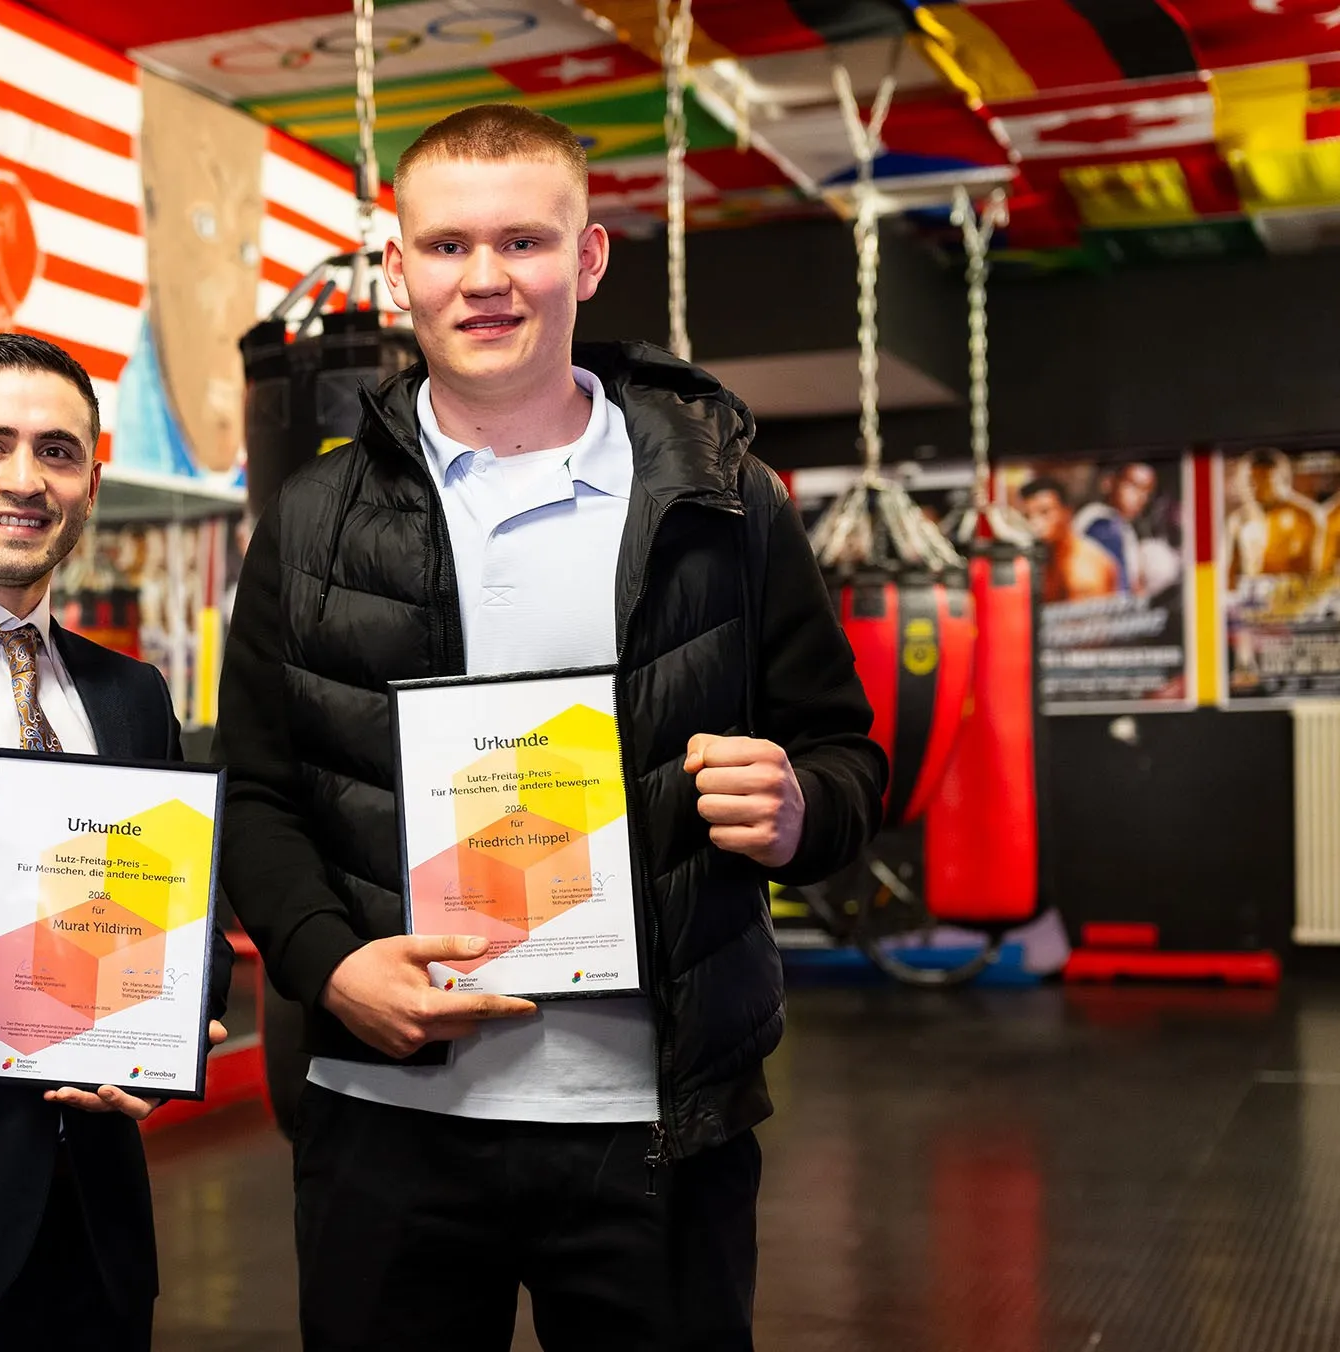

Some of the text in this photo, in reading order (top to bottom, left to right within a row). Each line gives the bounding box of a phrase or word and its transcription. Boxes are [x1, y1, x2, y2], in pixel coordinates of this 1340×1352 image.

[474, 733, 549, 751] Urkunde
[467, 770, 552, 783] Lutz-Freitag-Preis
[431, 777, 600, 797] Für Menschen, die andere bewegen
[505, 804, 528, 814] 2026
[68, 818, 142, 836] Urkunde
[510, 820, 524, 828] für
[468, 832, 570, 848] Friedrich Hippel
[55, 854, 140, 868] Lutz-Freitag-Preis
[17, 863, 185, 884] Für Menschen, die andere bewegen
[88, 891, 111, 900] 2026
[92, 906, 105, 914] für
[53, 919, 142, 935] Murat Yildirim
[586, 971, 619, 979] Gewobag
[144, 1069, 176, 1079] Gewobag
